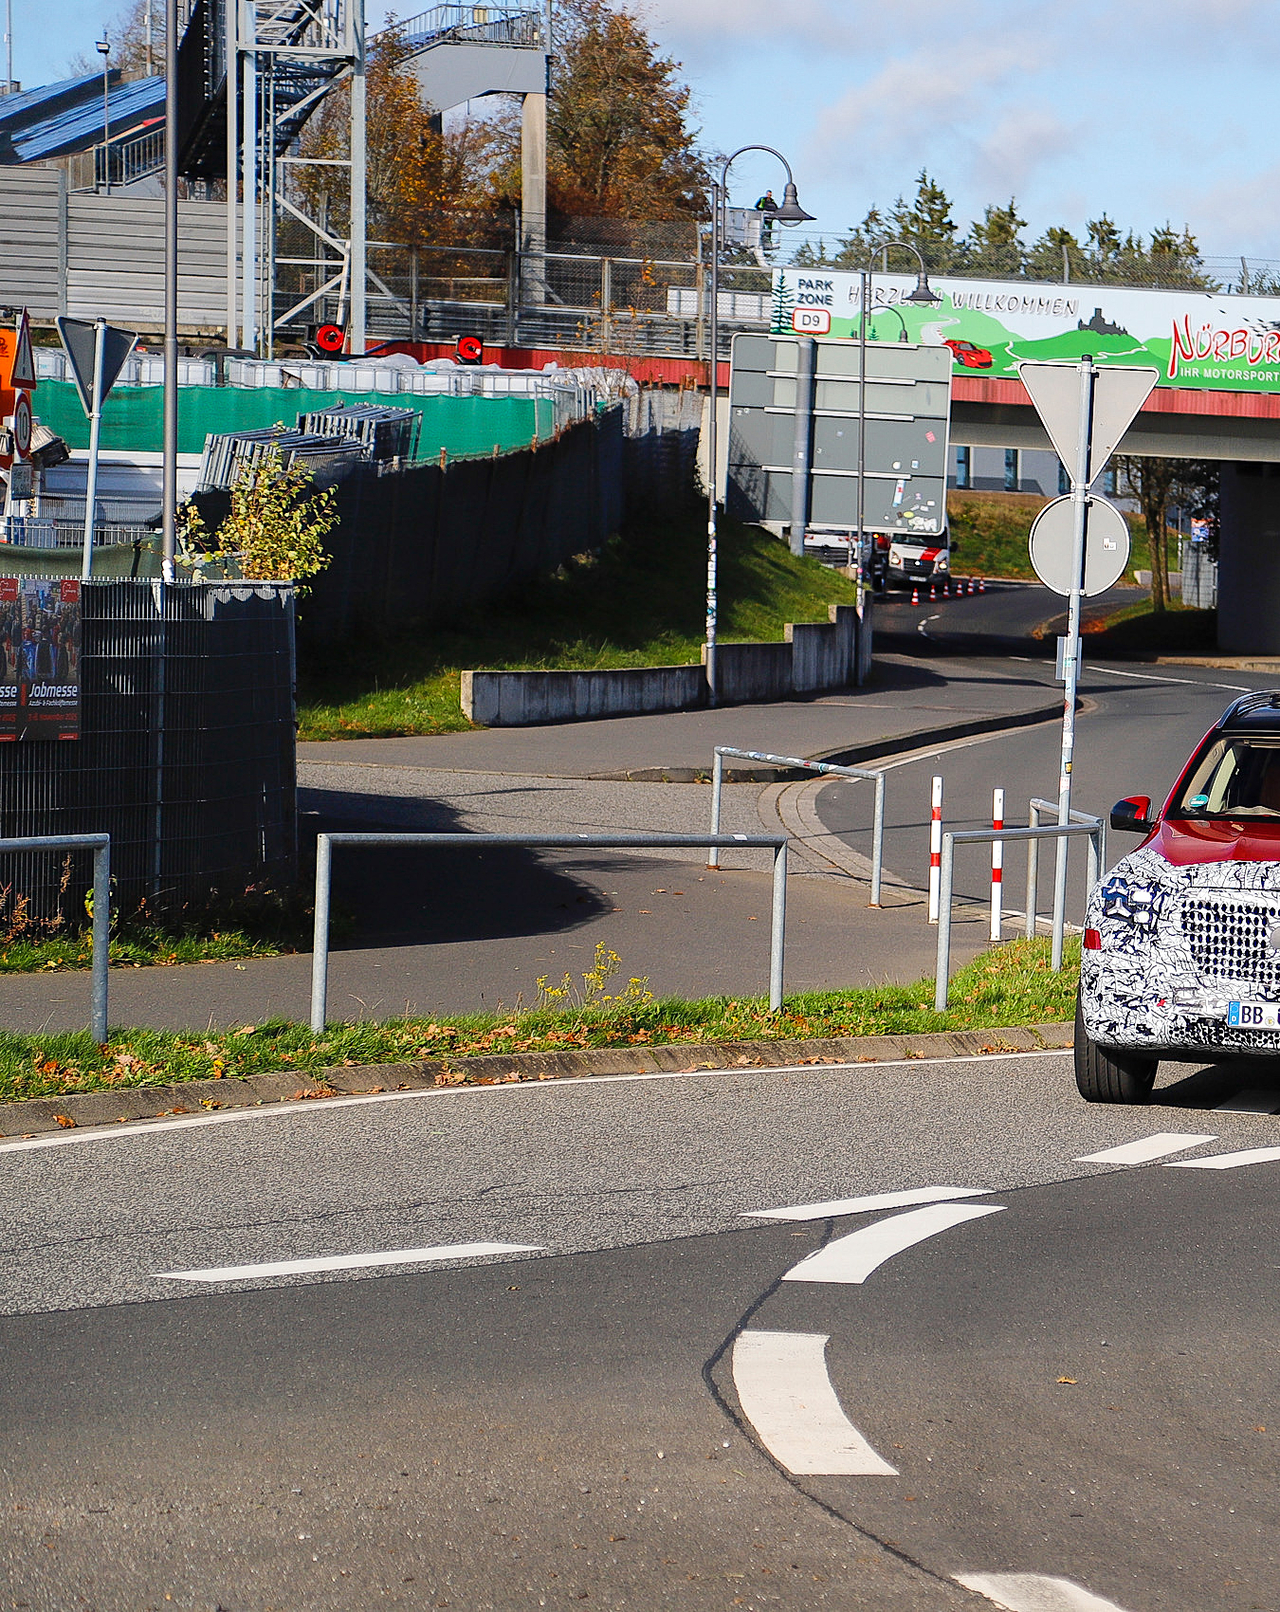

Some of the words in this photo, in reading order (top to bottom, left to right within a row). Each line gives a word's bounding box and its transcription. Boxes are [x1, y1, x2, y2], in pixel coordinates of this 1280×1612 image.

[798, 278, 834, 292] PARK
[797, 292, 833, 306] ZONE
[849, 285, 943, 310] HERZLH
[952, 291, 1079, 317] WILLKOMMEN
[802, 314, 820, 326] D9
[1180, 367, 1200, 378] IHR
[19, 412, 28, 440] 10
[28, 681, 78, 698] Jobmesse
[1241, 1005, 1263, 1024] BB
